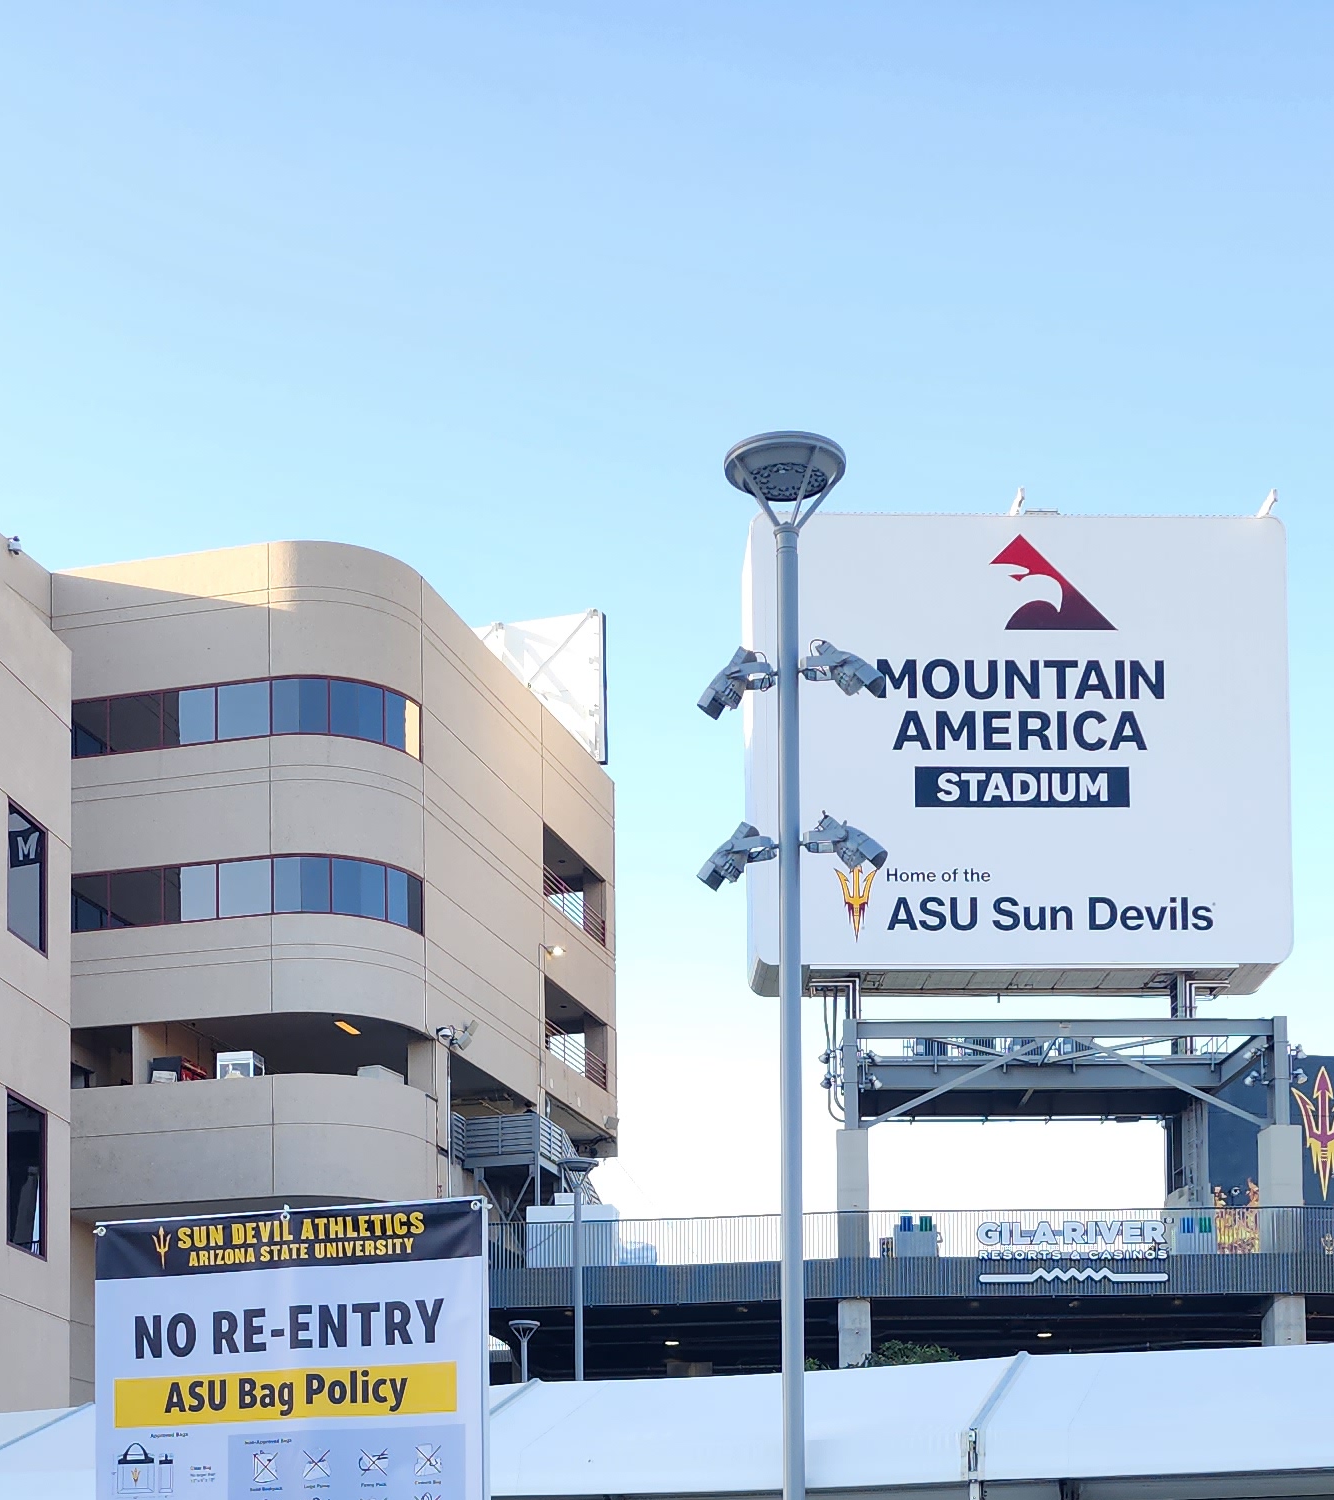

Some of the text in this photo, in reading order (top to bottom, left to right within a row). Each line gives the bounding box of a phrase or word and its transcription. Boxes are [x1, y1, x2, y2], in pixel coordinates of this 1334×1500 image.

[876, 658, 1166, 698] MOUNTAIN
[893, 711, 1147, 751] AMERICA
[937, 773, 1108, 801] STADIUM
[887, 868, 990, 882] Home of the
[887, 897, 1213, 931] ASU Sun Devils
[176, 1211, 426, 1250] SUN DEVIL ATHLETICS
[976, 1220, 1167, 1246] GILA RIVER
[188, 1237, 415, 1267] ARIZONA STATE UNIVERSITY
[979, 1250, 1168, 1260] RESORTS & CASINOS
[135, 1298, 444, 1359] NO RE-ENTRY
[164, 1370, 408, 1416] ASU Bag Policy
